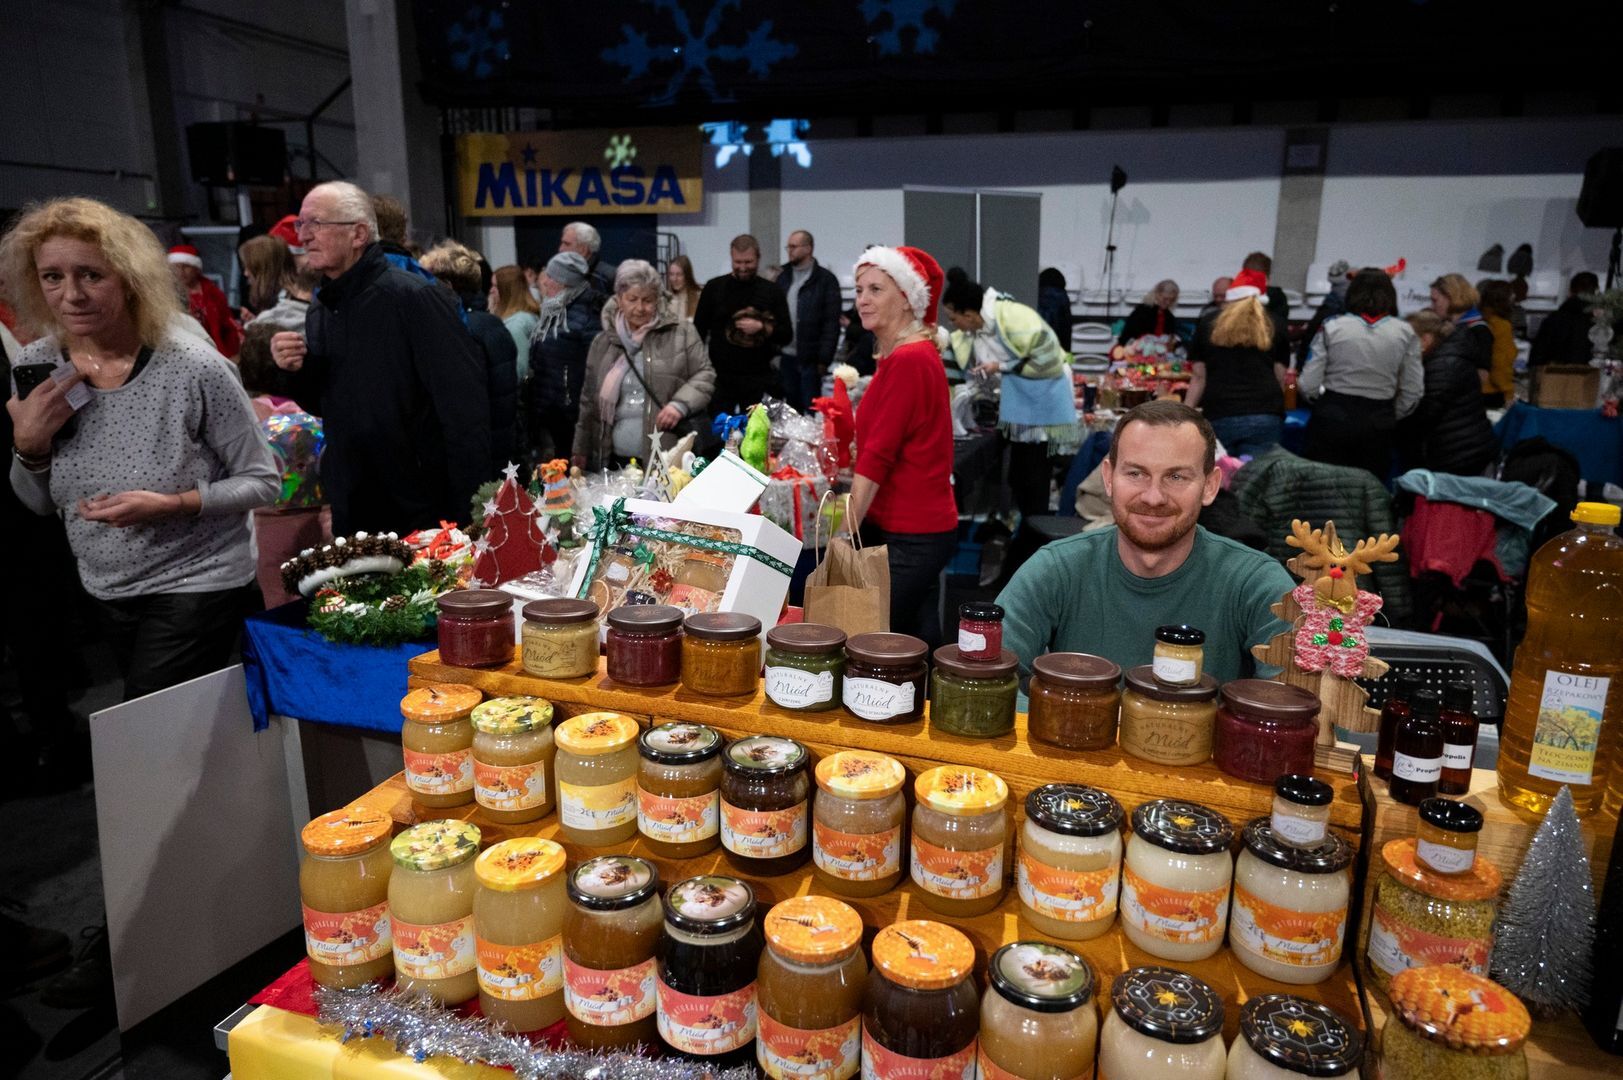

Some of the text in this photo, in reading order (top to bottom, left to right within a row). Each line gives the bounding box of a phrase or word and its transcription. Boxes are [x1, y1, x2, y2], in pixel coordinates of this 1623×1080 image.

[774, 680, 814, 697] Miód
[1557, 675, 1598, 691] OLEJ
[855, 691, 894, 708] Miód
[1144, 731, 1196, 750] Miód
[1554, 759, 1589, 769] ZIMNO
